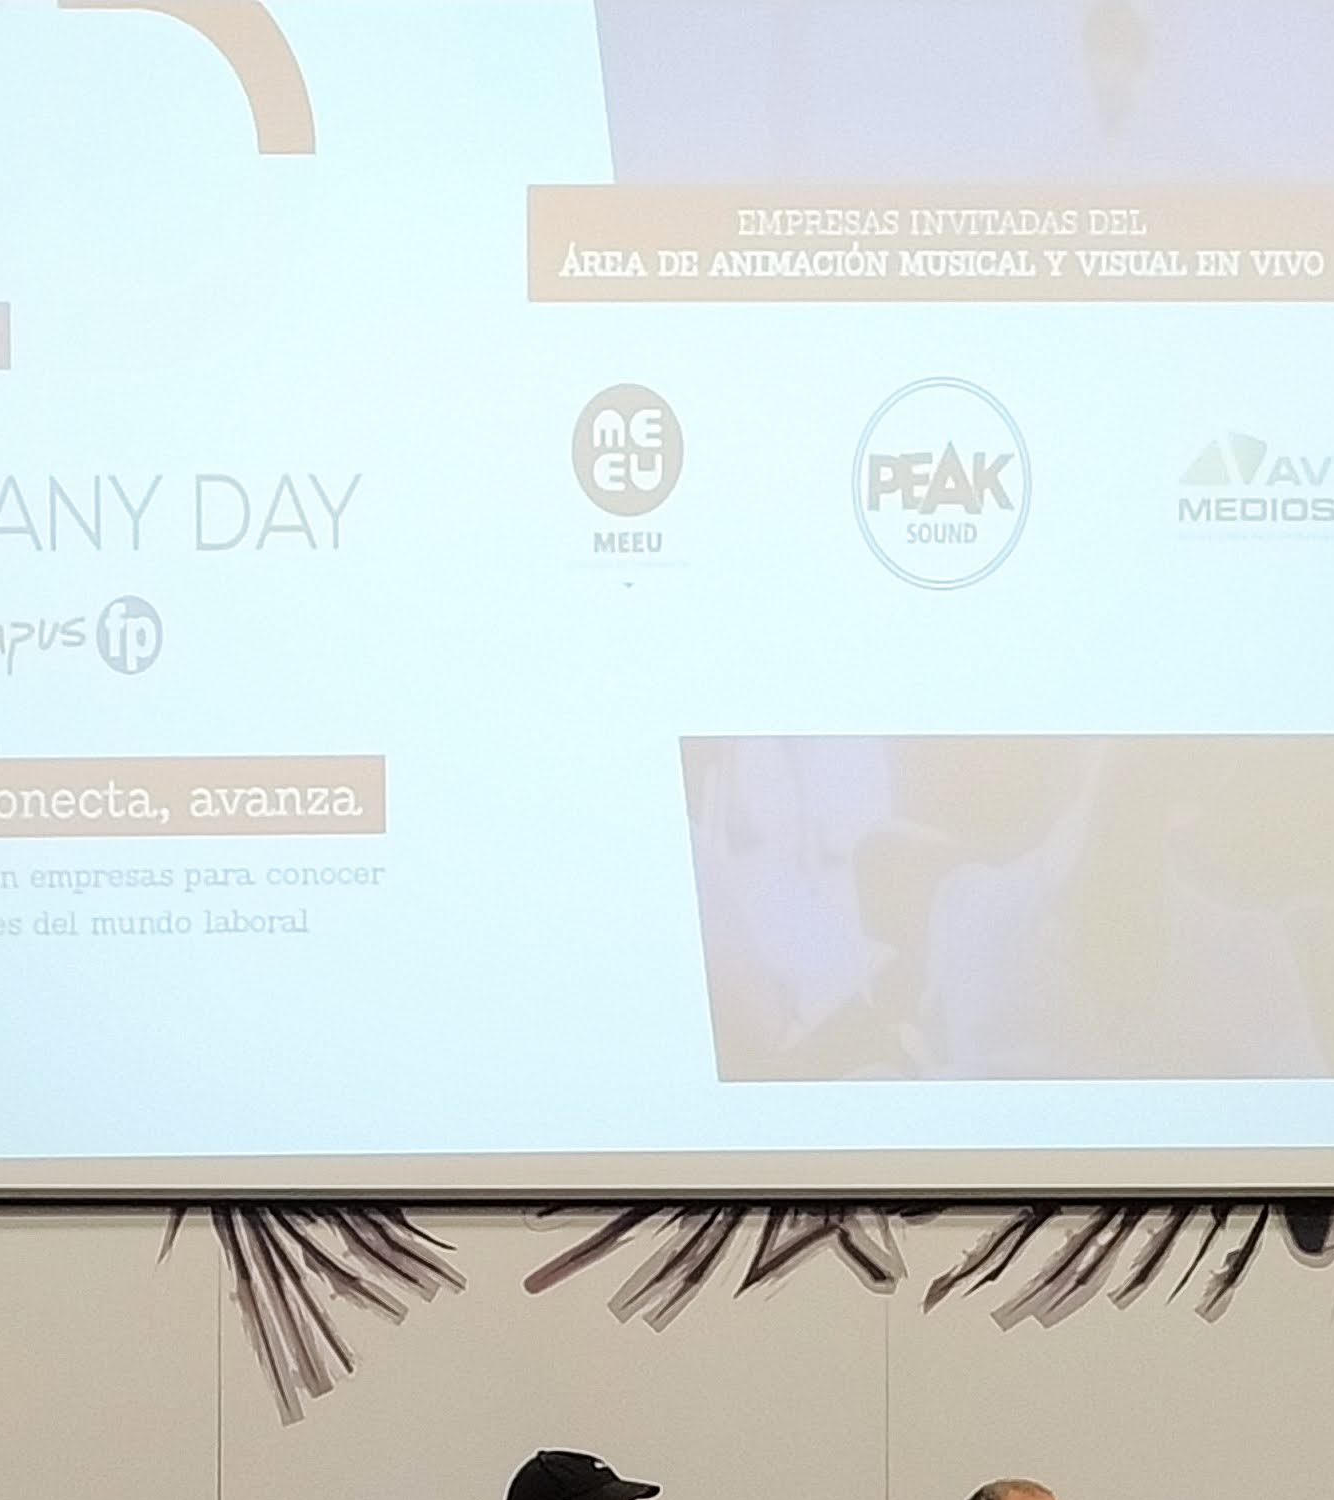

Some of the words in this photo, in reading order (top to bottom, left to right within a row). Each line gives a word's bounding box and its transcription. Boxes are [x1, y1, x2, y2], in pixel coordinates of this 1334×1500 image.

[738, 209, 899, 236] EMPRESAS
[910, 210, 1078, 235] INVITADAS
[1089, 209, 1147, 235] DEL
[559, 242, 648, 277] ÁREA
[658, 251, 698, 277] DE
[708, 241, 889, 277] ANIMACIÓN
[898, 251, 1036, 276] MUSICAL
[1044, 251, 1067, 276] Y
[1075, 251, 1187, 276] VISUAL
[1196, 251, 1241, 276] EN
[1250, 251, 1324, 276] VIVO
[867, 441, 1015, 515] PEAK
[1266, 456, 1334, 487] AV
[196, 473, 362, 551] DAY
[594, 532, 662, 553] MEEU
[907, 522, 977, 544] SOUND
[104, 606, 158, 671] fp
[190, 783, 363, 818] avanza
[30, 869, 173, 895] empresas
[184, 868, 256, 893] para
[266, 867, 386, 886] conocer
[33, 911, 78, 936] del
[91, 911, 191, 936] mundo
[204, 909, 309, 934] laboral
